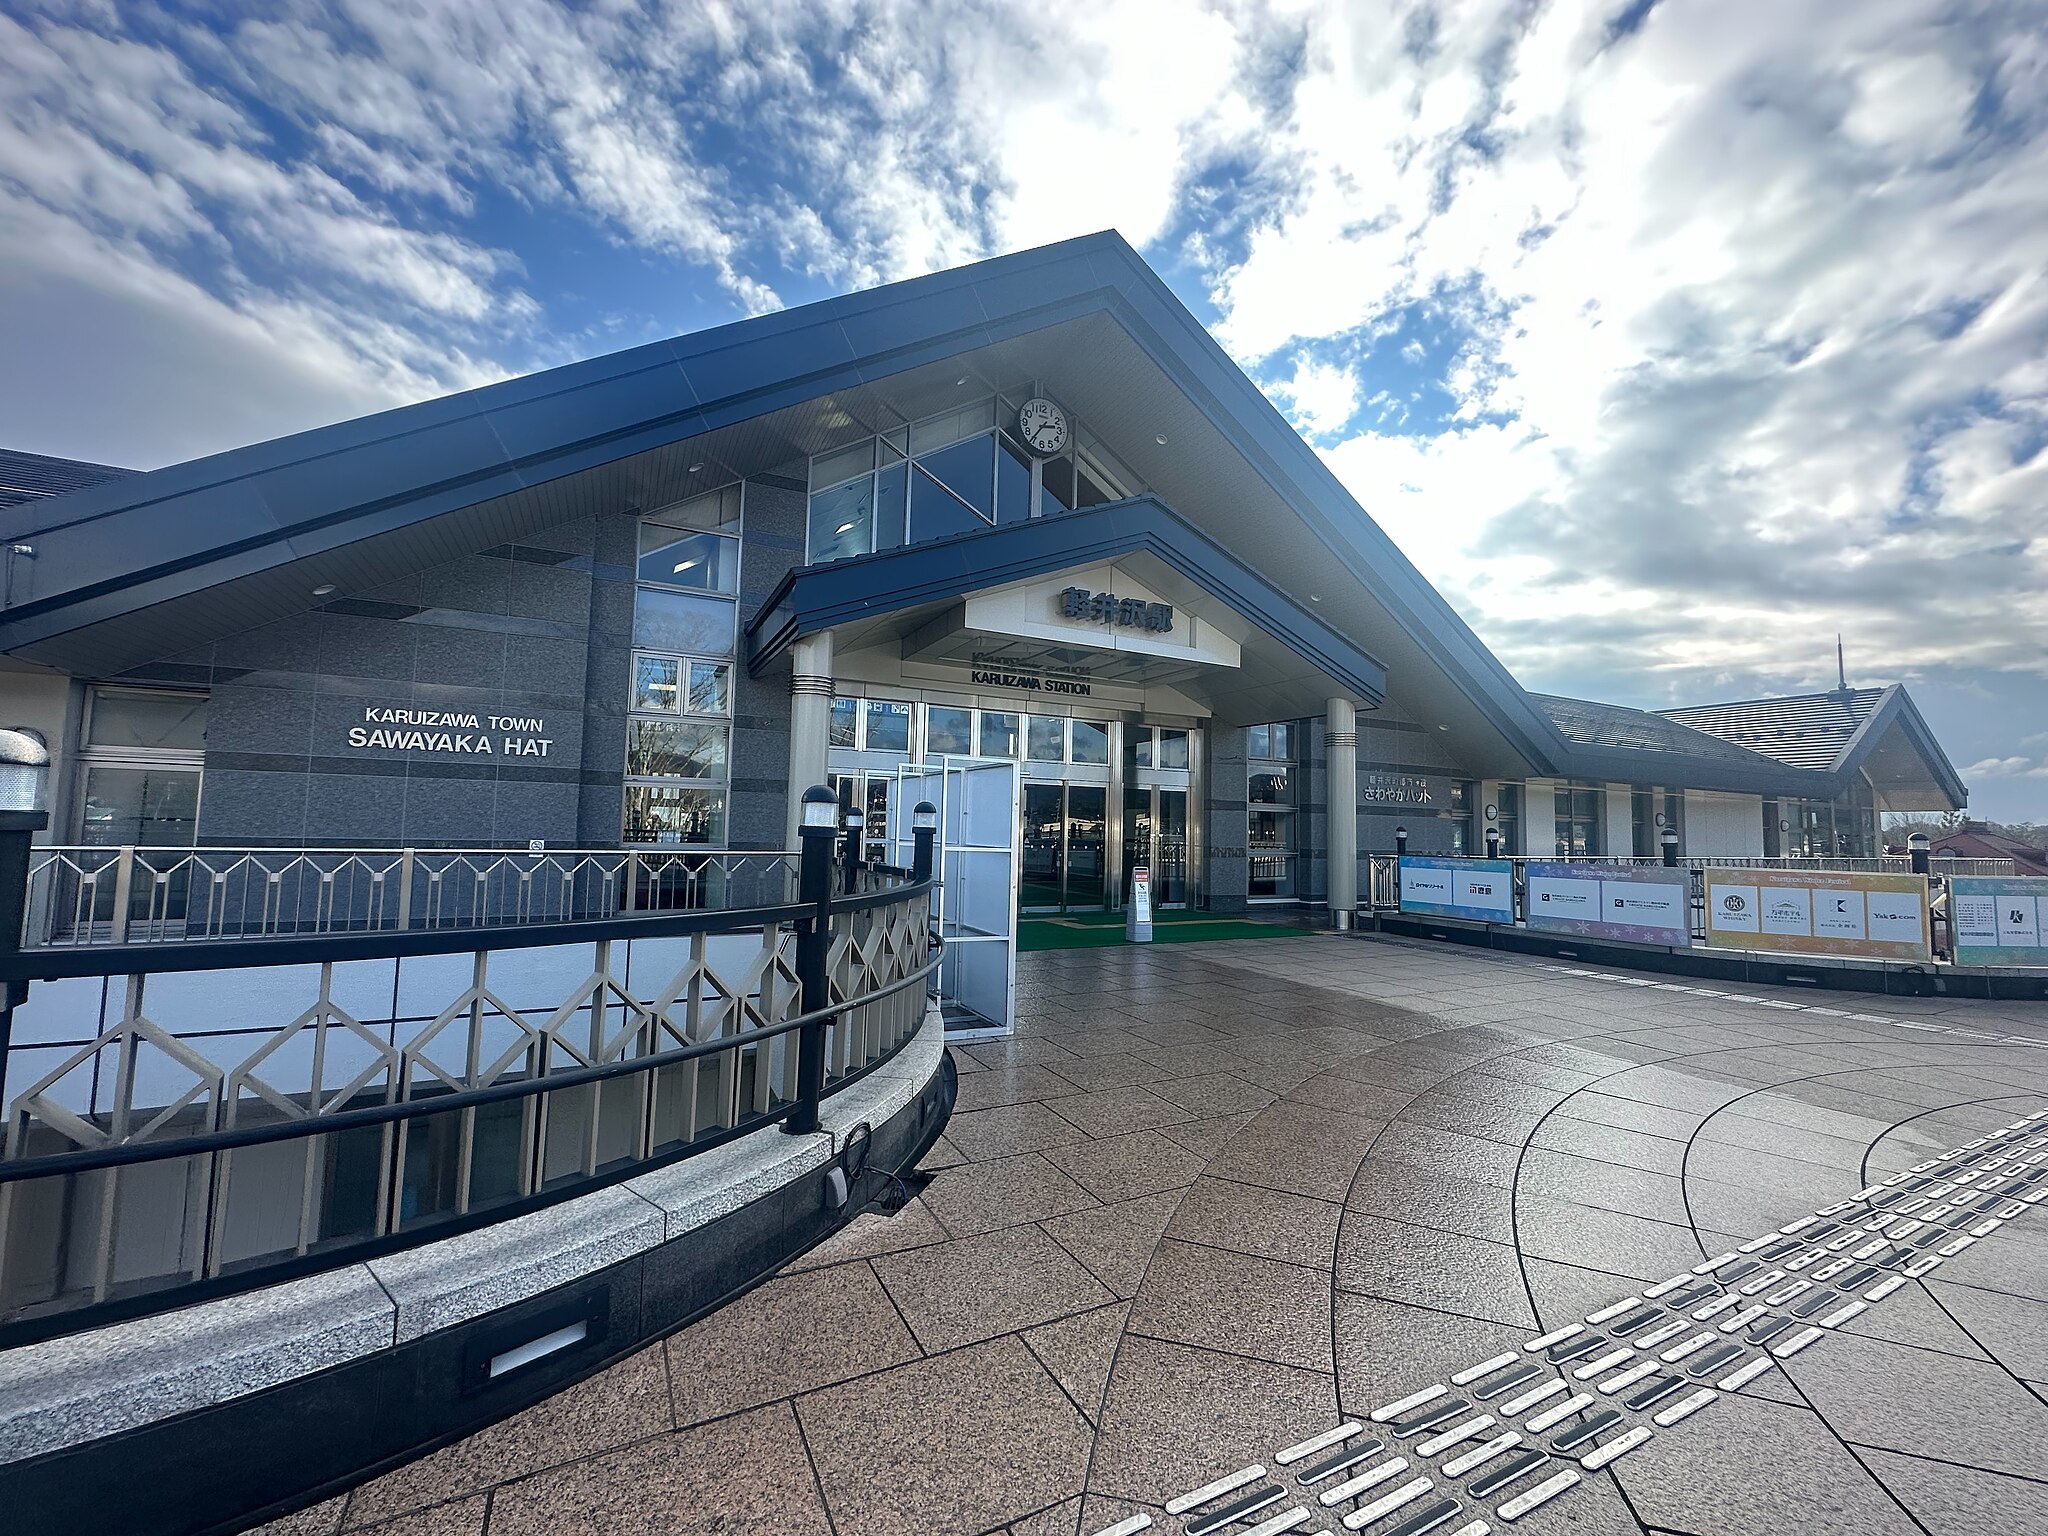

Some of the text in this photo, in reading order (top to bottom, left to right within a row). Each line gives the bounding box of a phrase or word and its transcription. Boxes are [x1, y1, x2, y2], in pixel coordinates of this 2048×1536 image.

[1031, 402, 1038, 413] 11
[1039, 404, 1047, 413] 12
[1024, 409, 1032, 418] 10
[1022, 417, 1028, 426] 9
[1054, 416, 1060, 425] 2
[1025, 427, 1030, 435] 8
[1056, 426, 1062, 435] 3
[1053, 435, 1059, 443] 4
[1039, 440, 1045, 448] 6
[1047, 440, 1053, 448] 5
[1061, 587, 1174, 632] 軽井沢駅
[971, 671, 1091, 696] KARUIZAWA STATION
[365, 707, 544, 733] KARUIZAWA TOWN
[348, 727, 553, 757] SAWAYAKA HAT
[1364, 786, 1432, 804] さわやかハット
